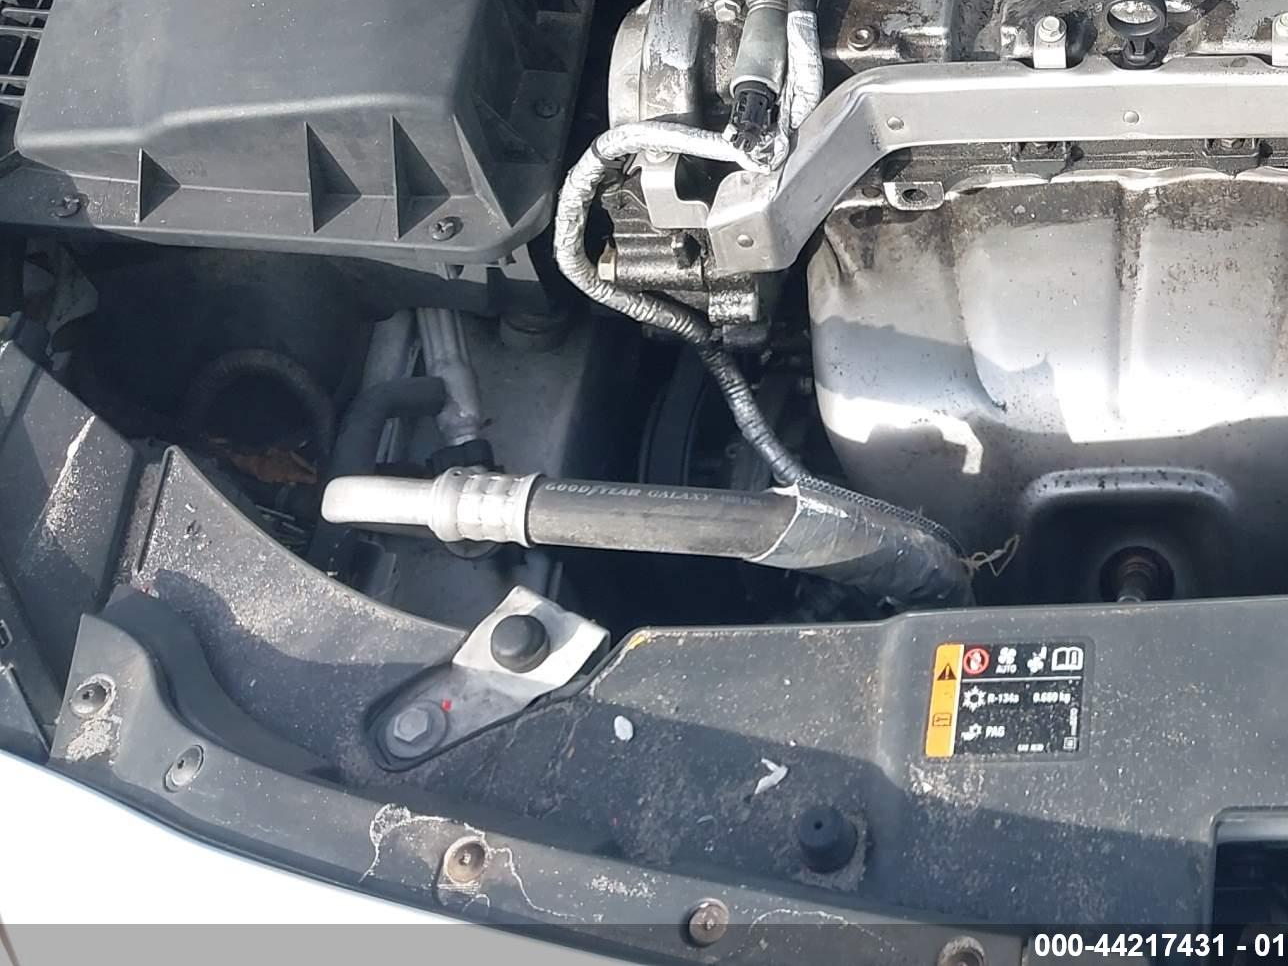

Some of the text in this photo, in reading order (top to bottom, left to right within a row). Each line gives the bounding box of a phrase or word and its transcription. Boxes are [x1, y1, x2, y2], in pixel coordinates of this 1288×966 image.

[545, 483, 642, 497] GOODYEAR
[648, 490, 712, 502] GALAXY
[995, 664, 1018, 674] AUTO
[987, 692, 1020, 704] R-134a
